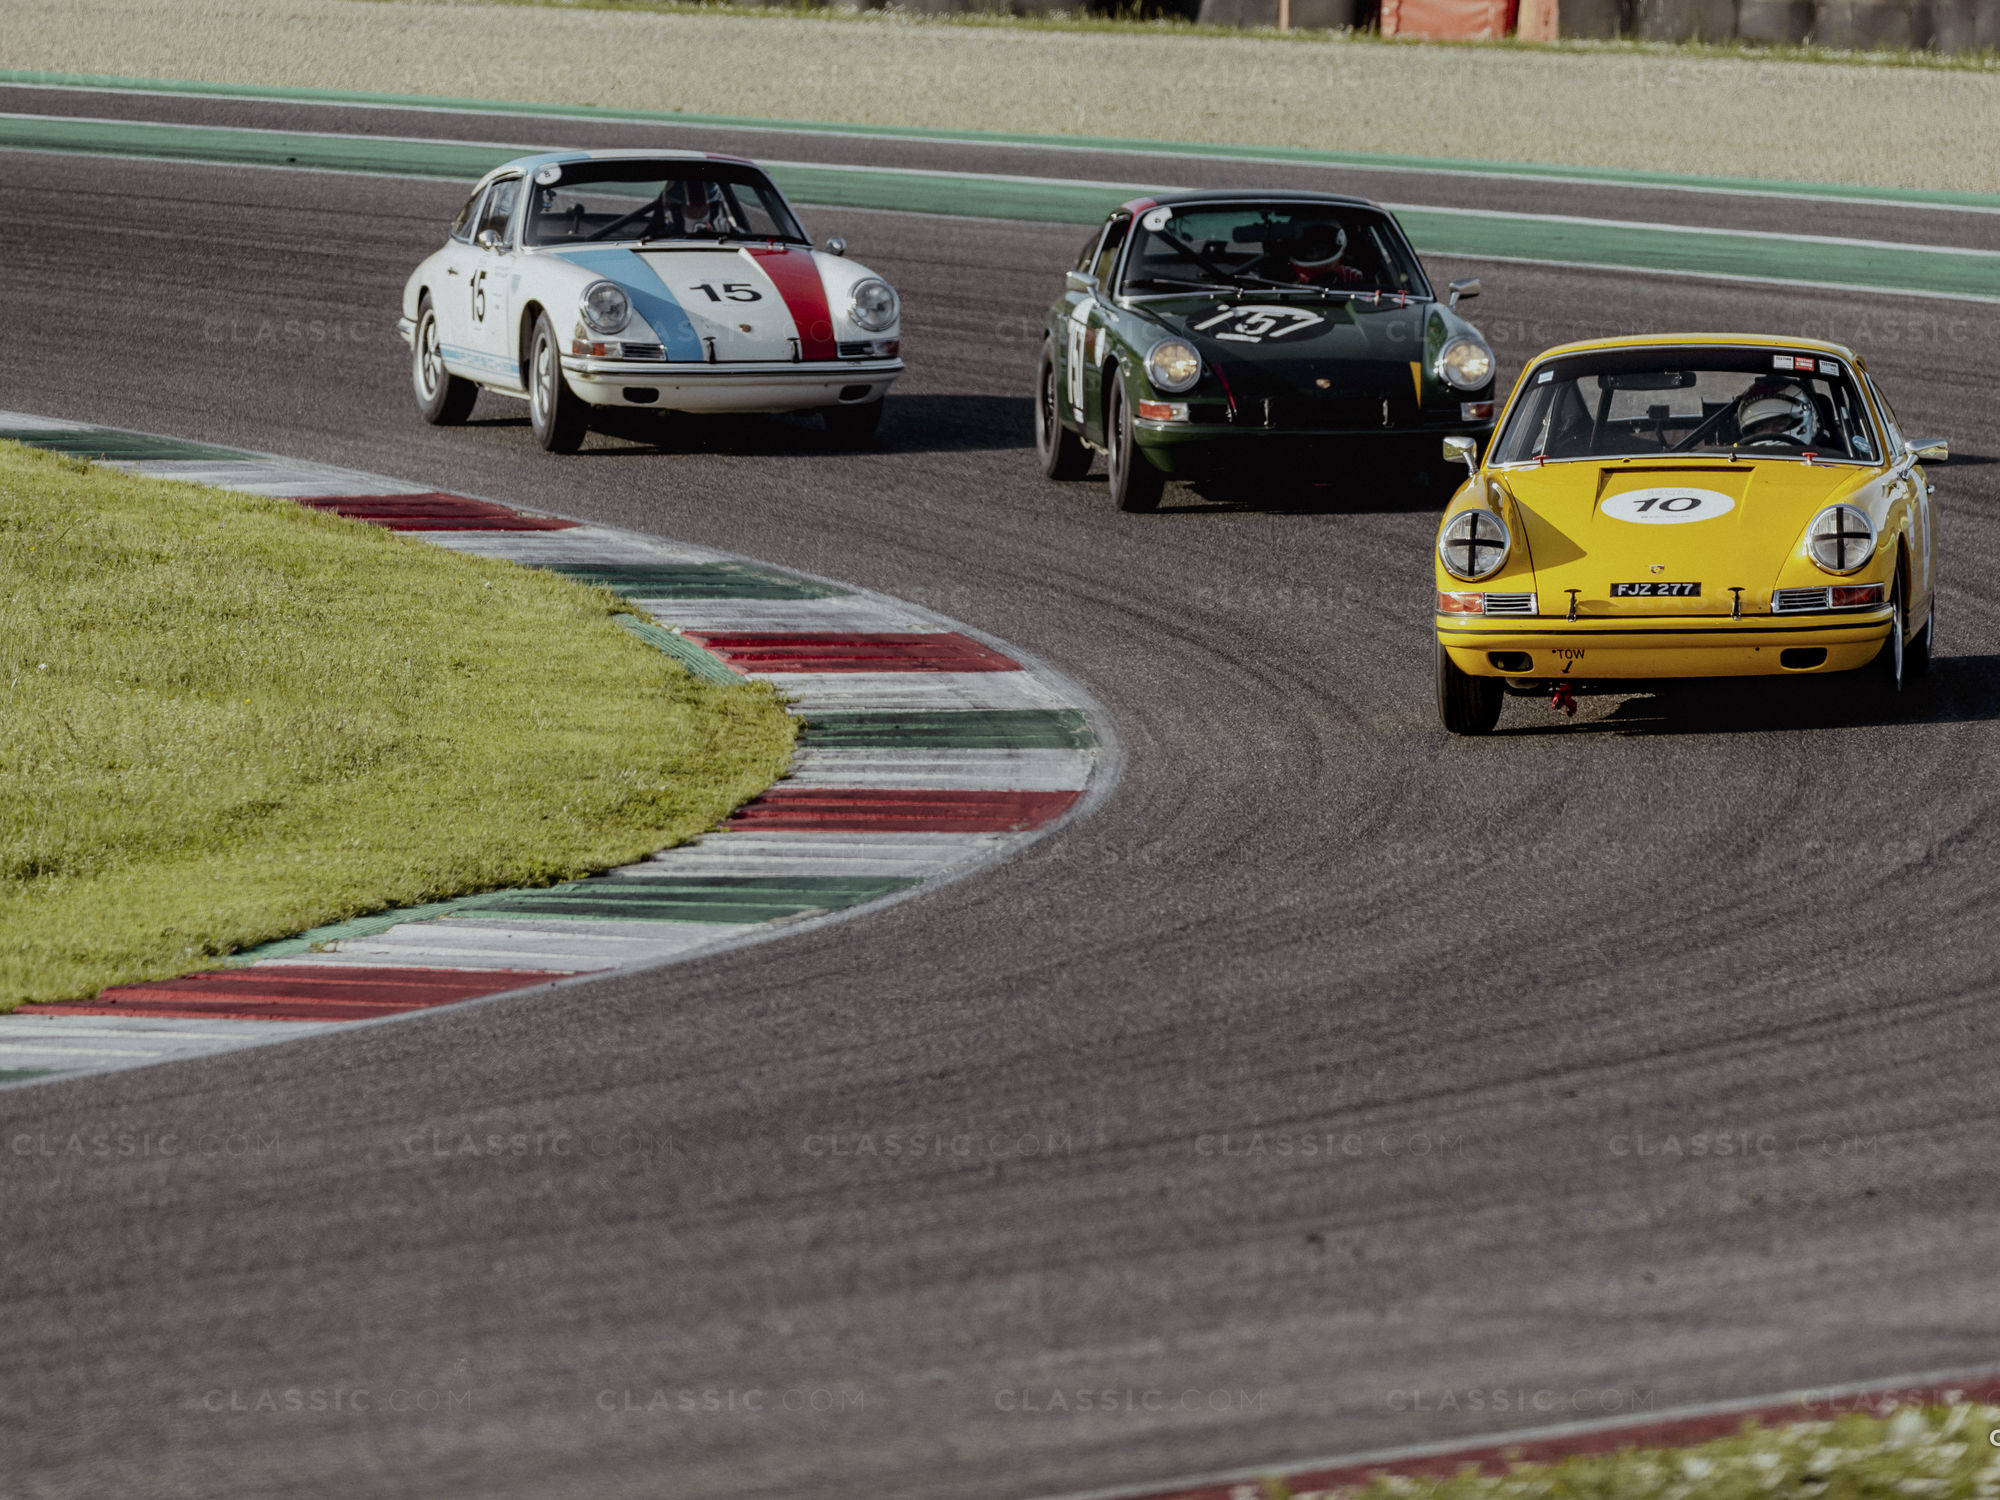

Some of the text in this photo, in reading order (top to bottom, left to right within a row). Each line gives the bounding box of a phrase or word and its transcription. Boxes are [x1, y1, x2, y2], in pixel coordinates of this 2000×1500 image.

[469, 268, 488, 323] 15
[689, 283, 762, 302] 15
[1633, 497, 1702, 512] 10
[1617, 583, 1694, 596] FJZ 277
[1556, 648, 1585, 660] TOW
